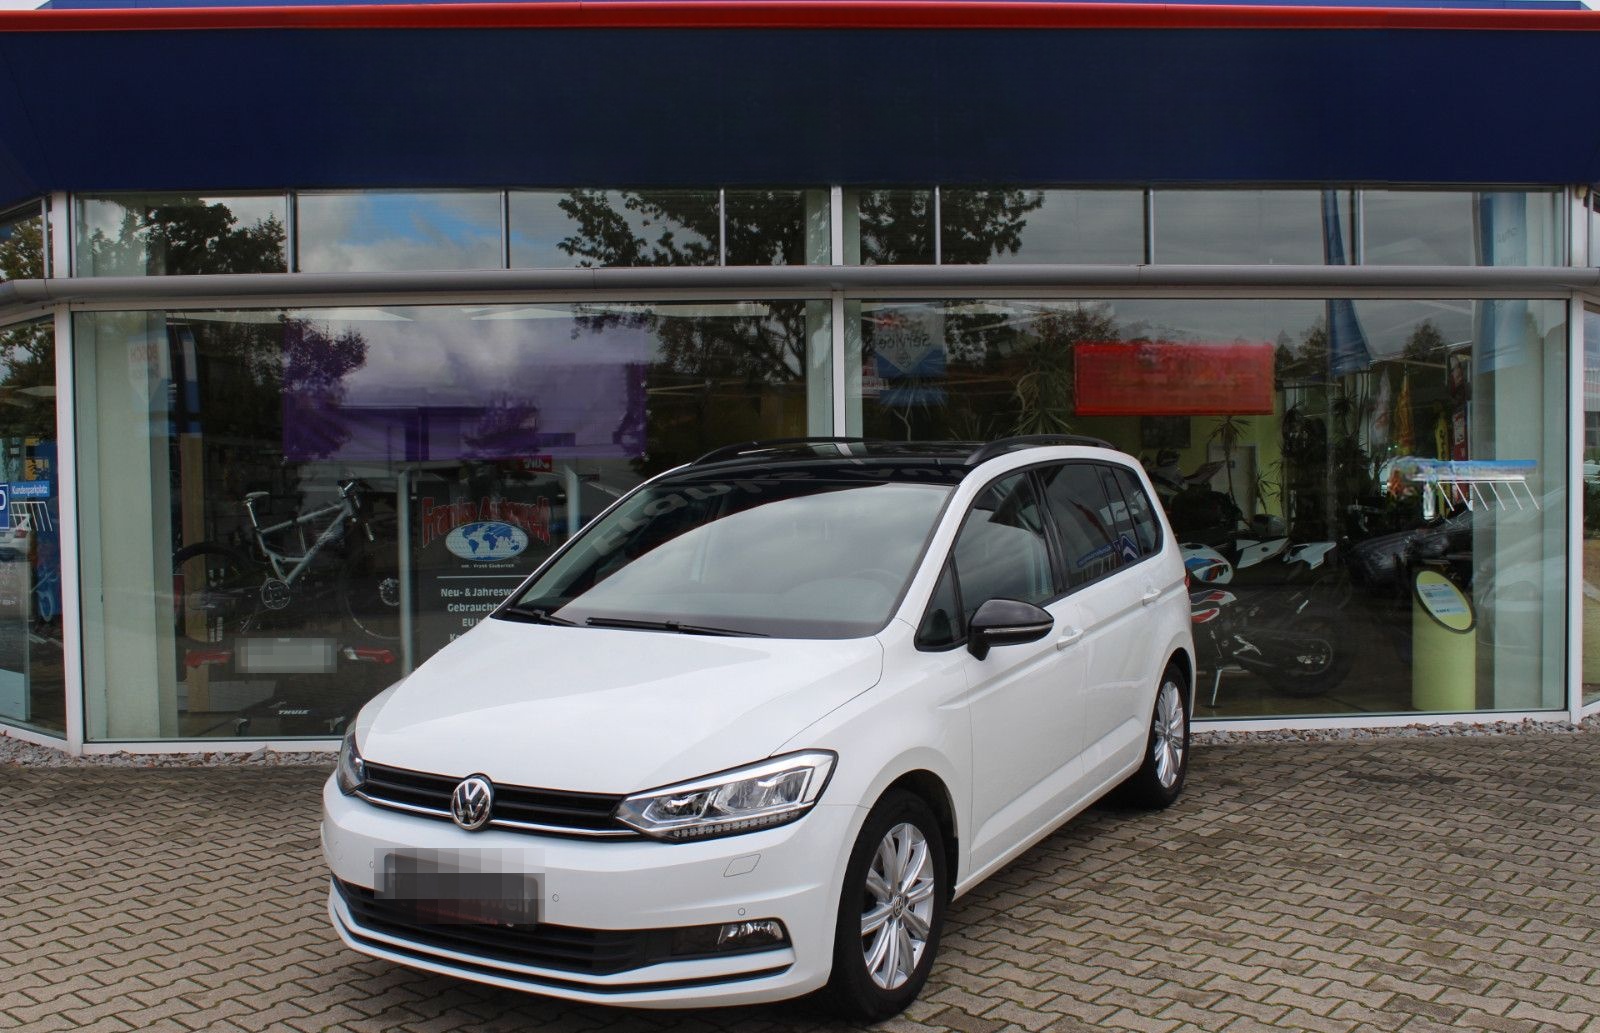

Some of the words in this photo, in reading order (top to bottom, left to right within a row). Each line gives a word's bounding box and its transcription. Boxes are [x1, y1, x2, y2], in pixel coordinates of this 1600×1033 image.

[441, 588, 463, 597] Neu-
[464, 588, 471, 596] &
[462, 618, 474, 627] EU
